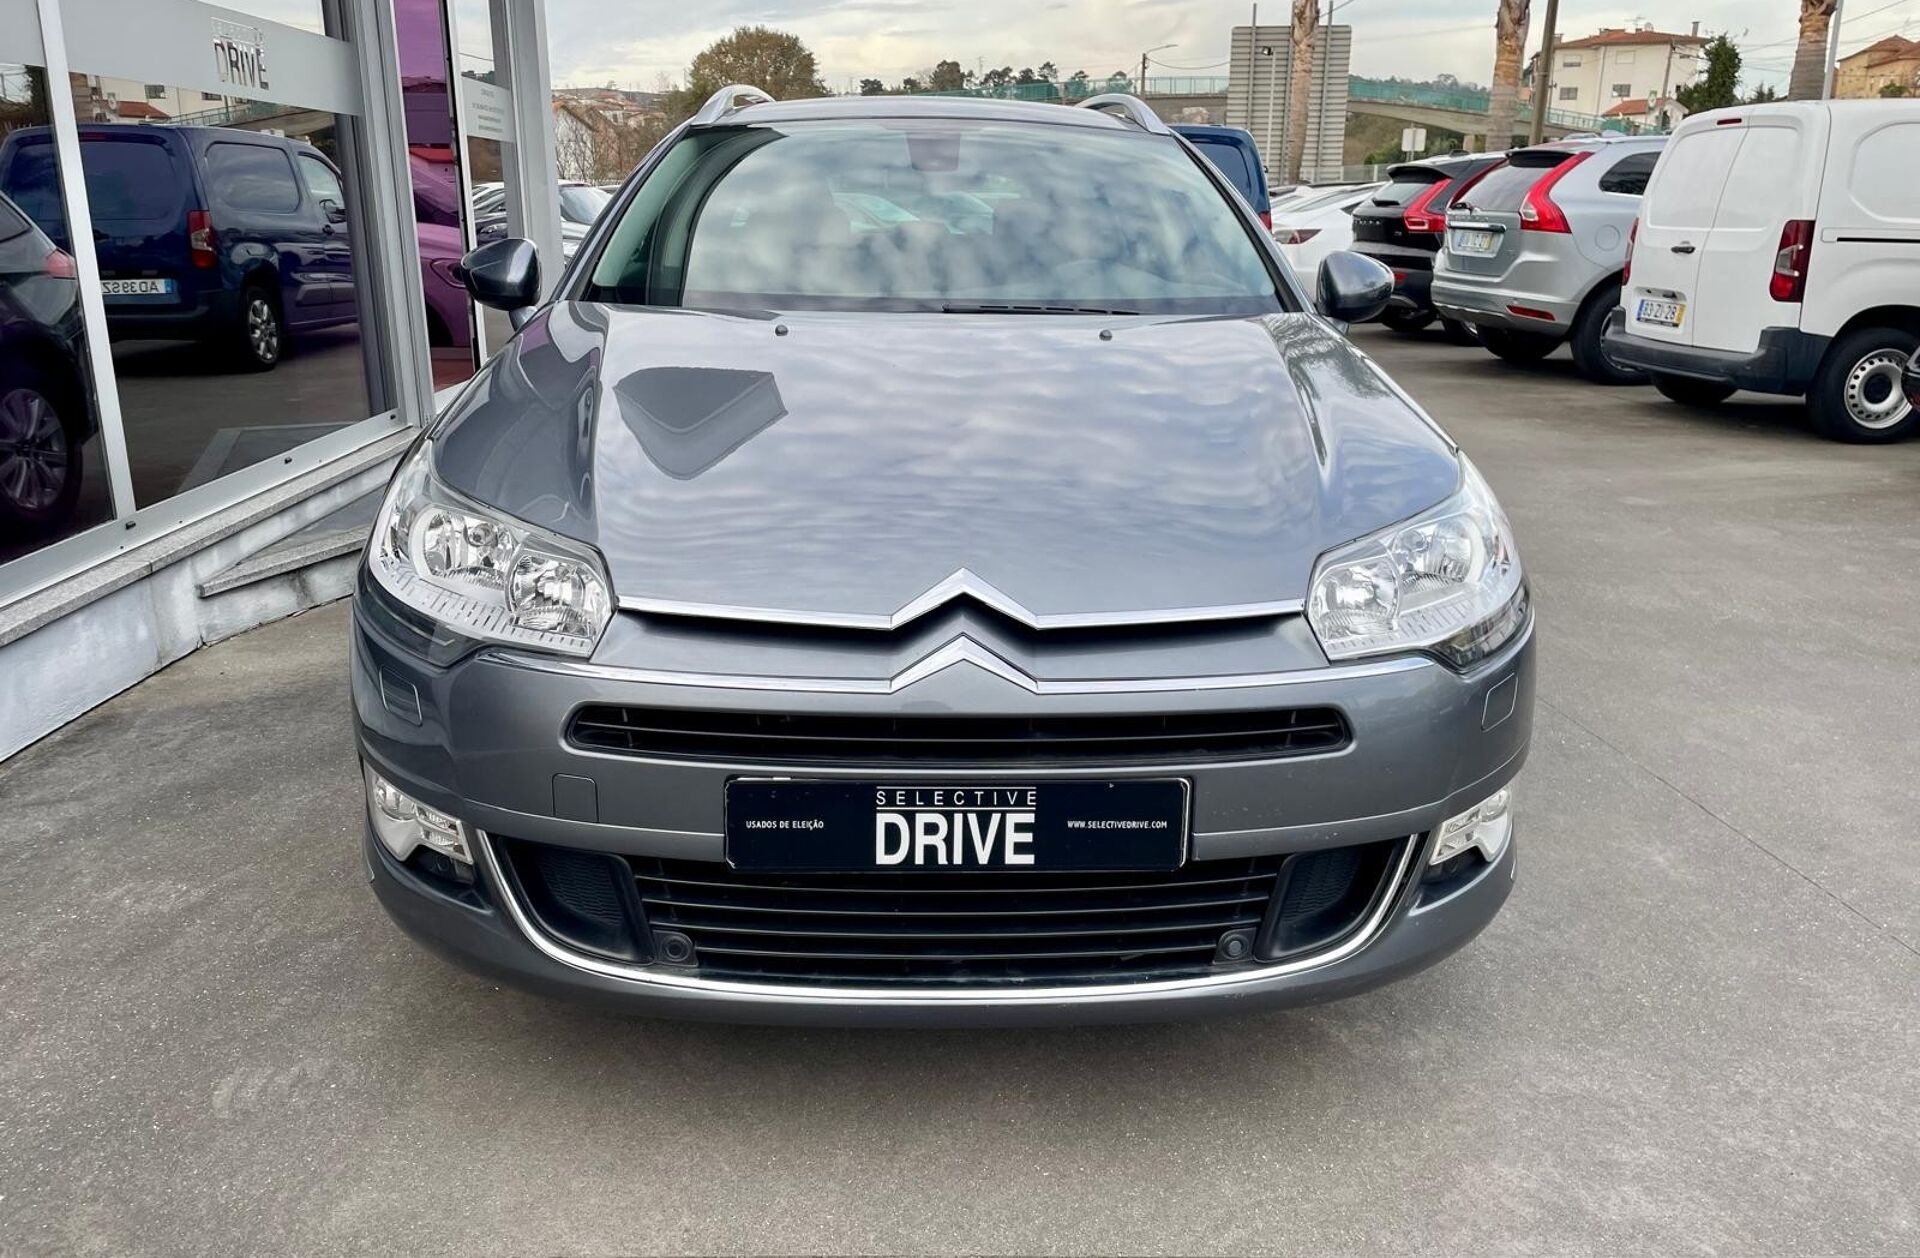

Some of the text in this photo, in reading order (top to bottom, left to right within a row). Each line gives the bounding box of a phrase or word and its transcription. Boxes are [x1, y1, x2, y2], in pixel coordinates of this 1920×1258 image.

[213, 38, 269, 90] DRIVE
[876, 791, 1037, 805] SELECTIVE
[745, 819, 825, 831] USADOS DE ELEIÇÃO
[1067, 820, 1168, 829] WWW.SELECTIVEDRIVE.COM
[876, 813, 1036, 865] DRIVE
